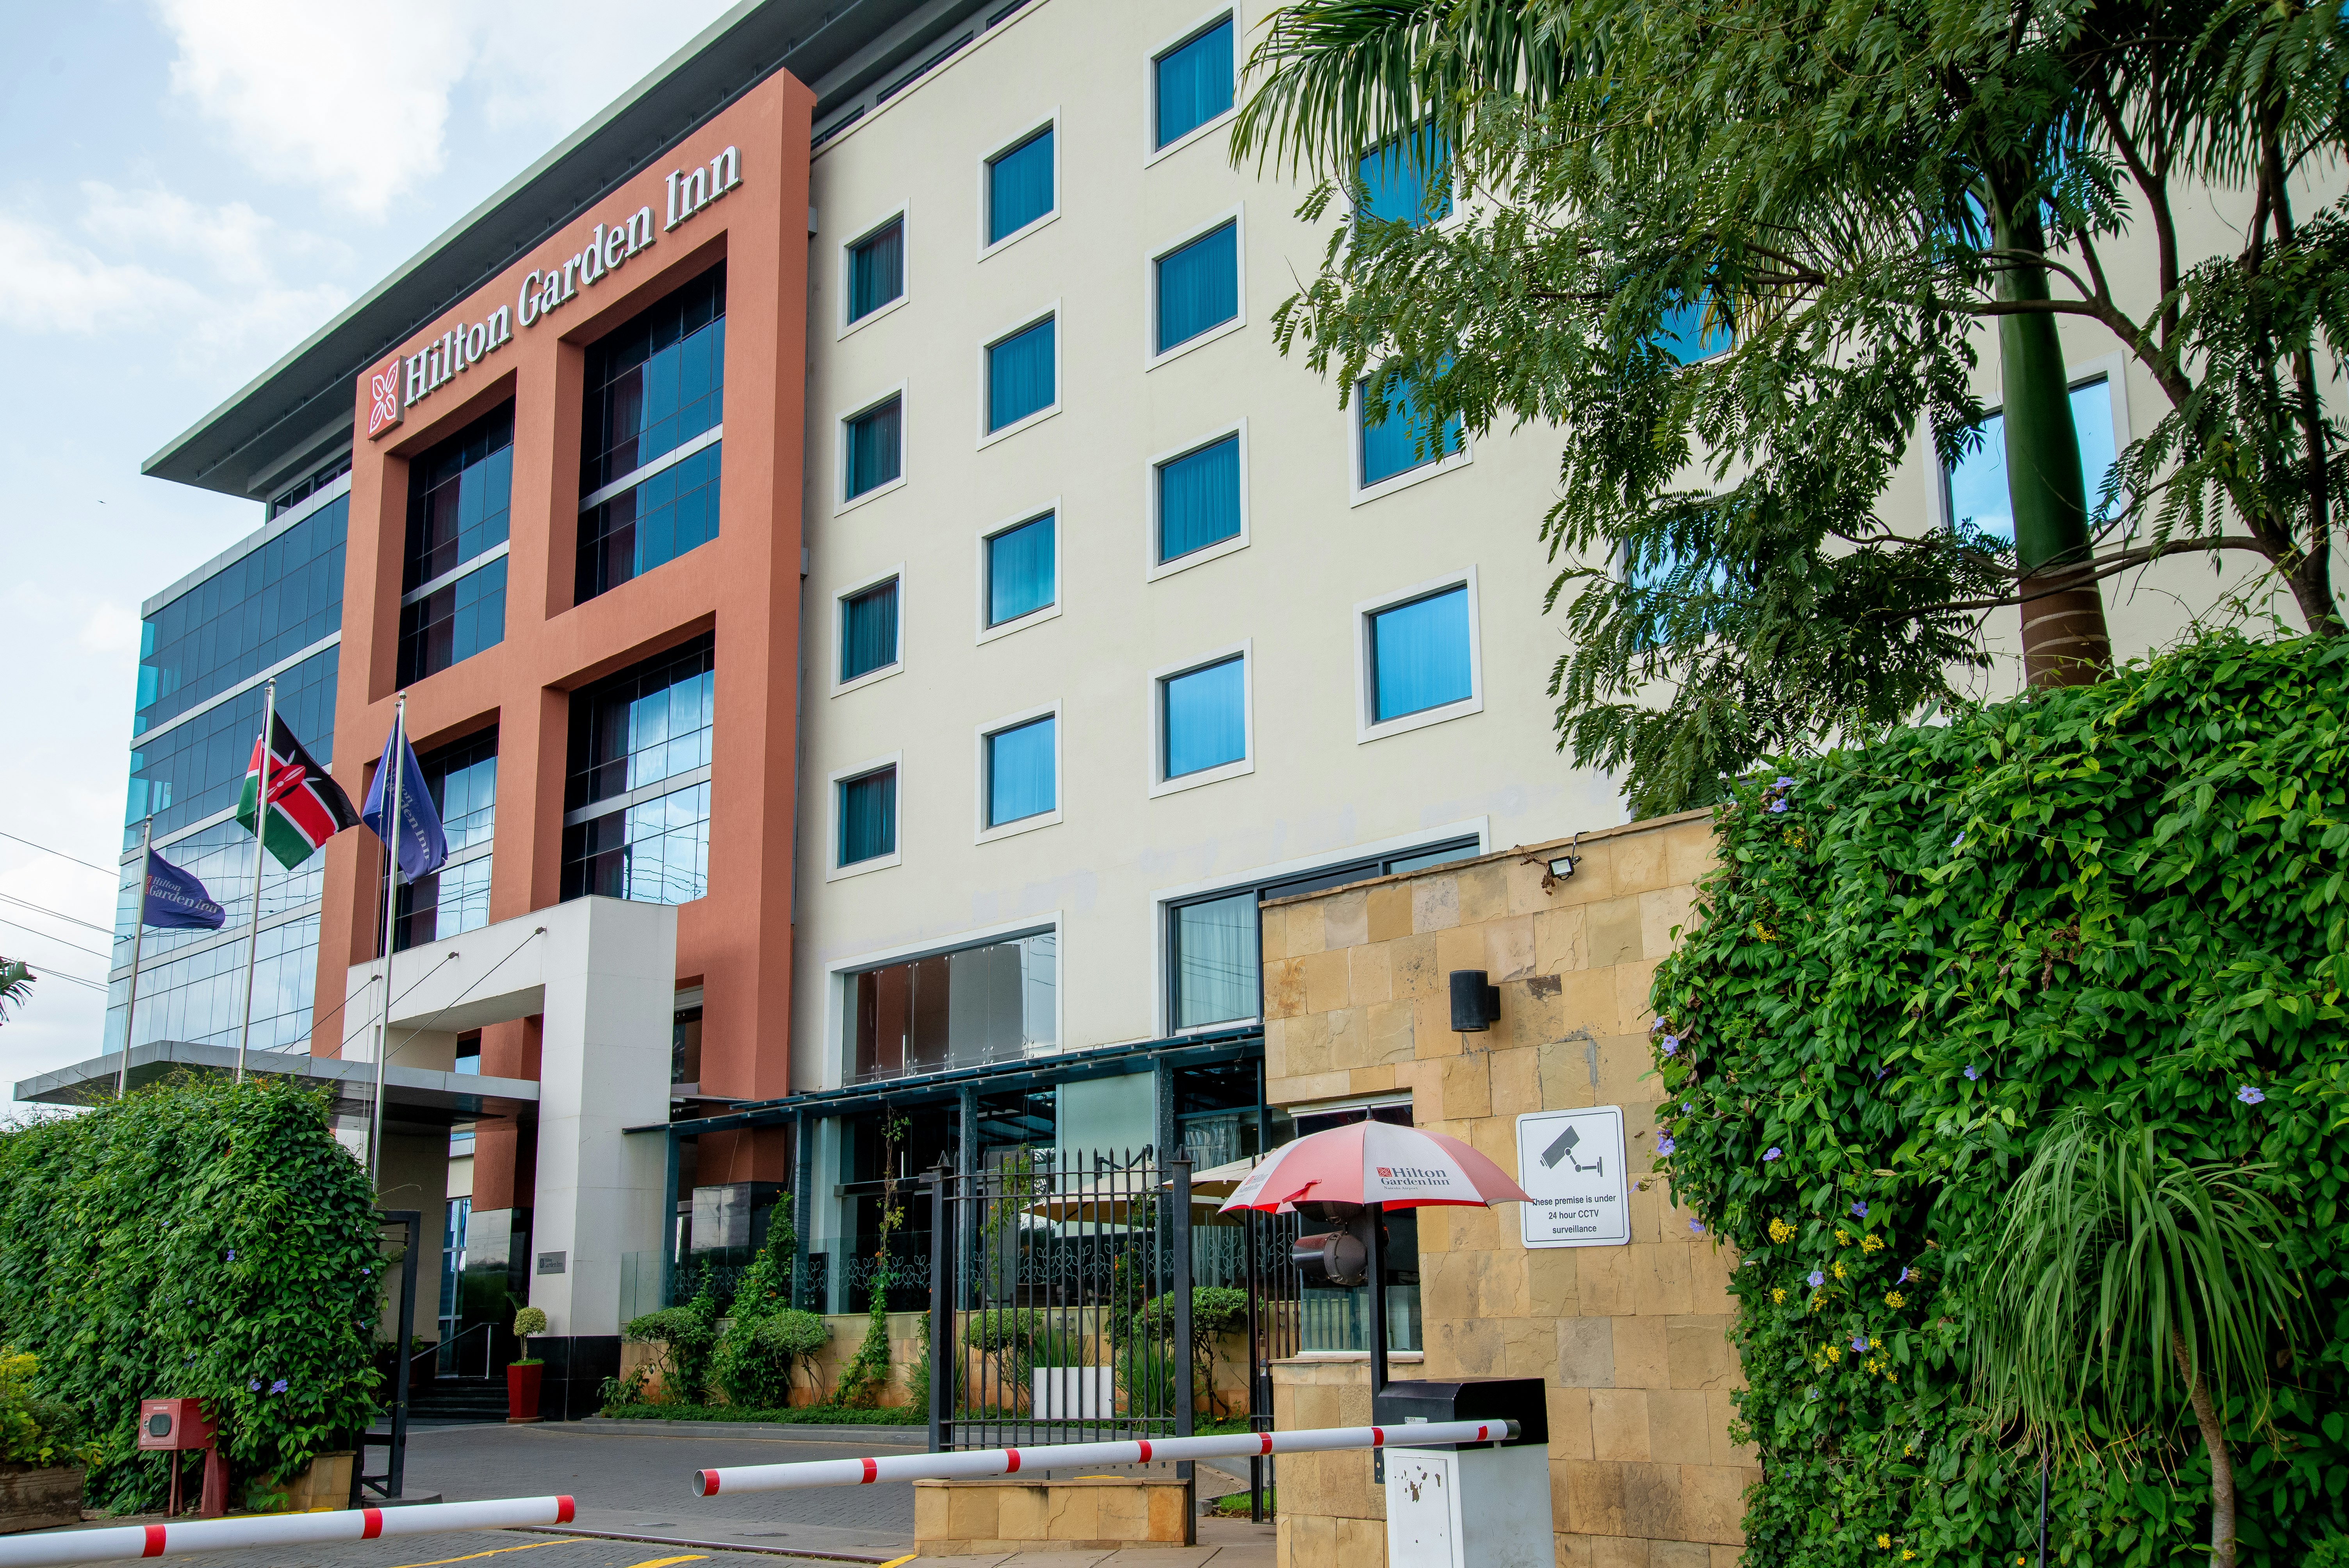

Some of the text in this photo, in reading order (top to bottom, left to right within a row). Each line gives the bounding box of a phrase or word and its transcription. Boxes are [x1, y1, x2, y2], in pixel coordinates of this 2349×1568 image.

[404, 146, 743, 408] Hilton Garden Inn
[152, 877, 181, 892] Hilton
[150, 885, 218, 914] Garden Inn
[1391, 1168, 1447, 1177] Hilton
[1555, 1196, 1584, 1206] premise
[1594, 1194, 1616, 1203] under
[1578, 1209, 1599, 1218] CCTV
[1552, 1225, 1597, 1234] surveillance
